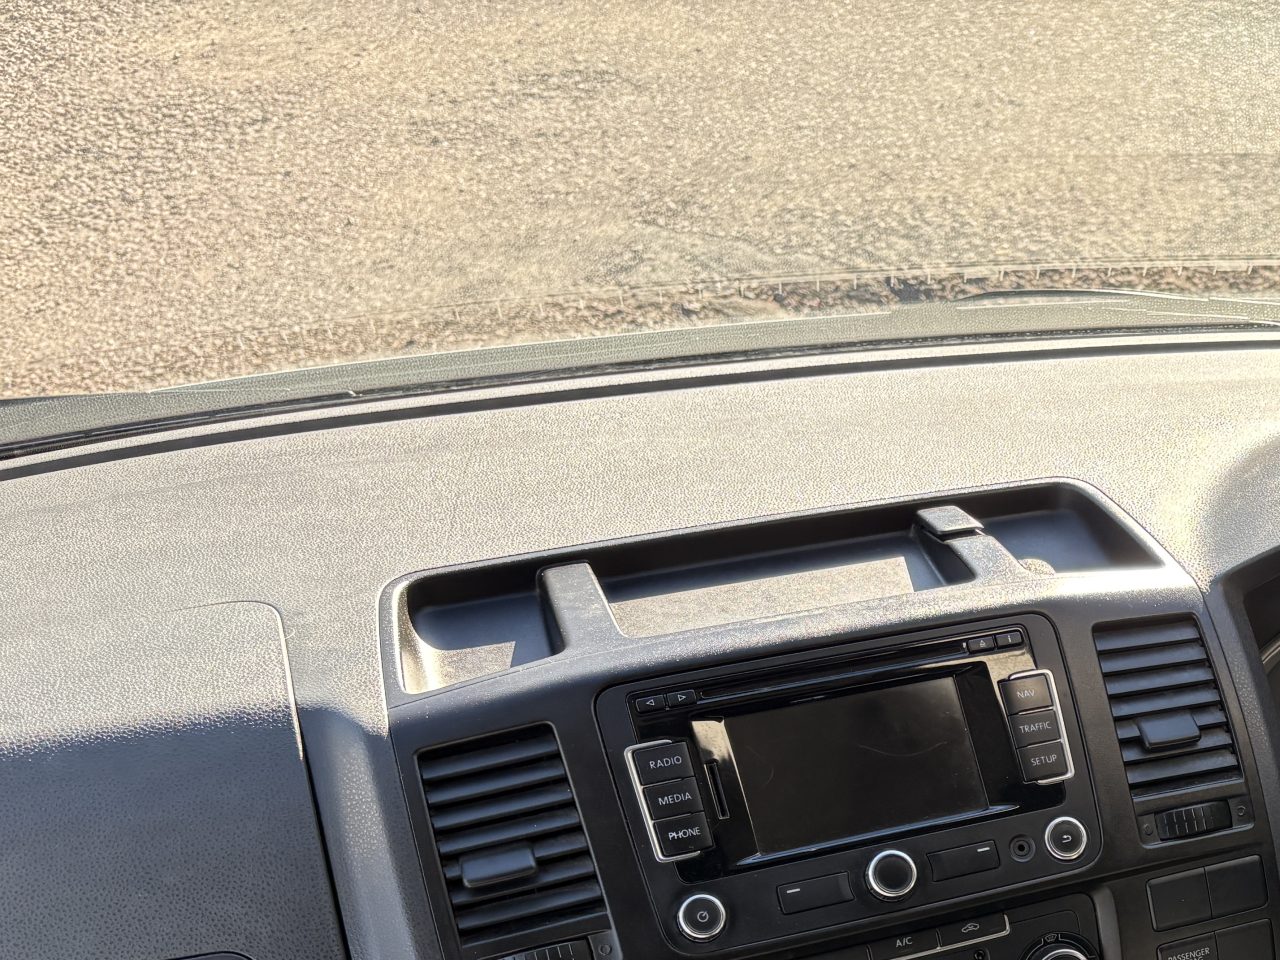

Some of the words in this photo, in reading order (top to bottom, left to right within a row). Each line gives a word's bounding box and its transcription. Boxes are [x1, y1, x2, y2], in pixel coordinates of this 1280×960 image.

[1016, 689, 1035, 698] NAV
[1019, 721, 1052, 733] TRAFFIC
[649, 756, 682, 769] RADIO
[1031, 754, 1057, 767] SETUP
[658, 792, 692, 806] MEDIA
[668, 827, 701, 841] PHONE
[896, 937, 913, 948] A/C
